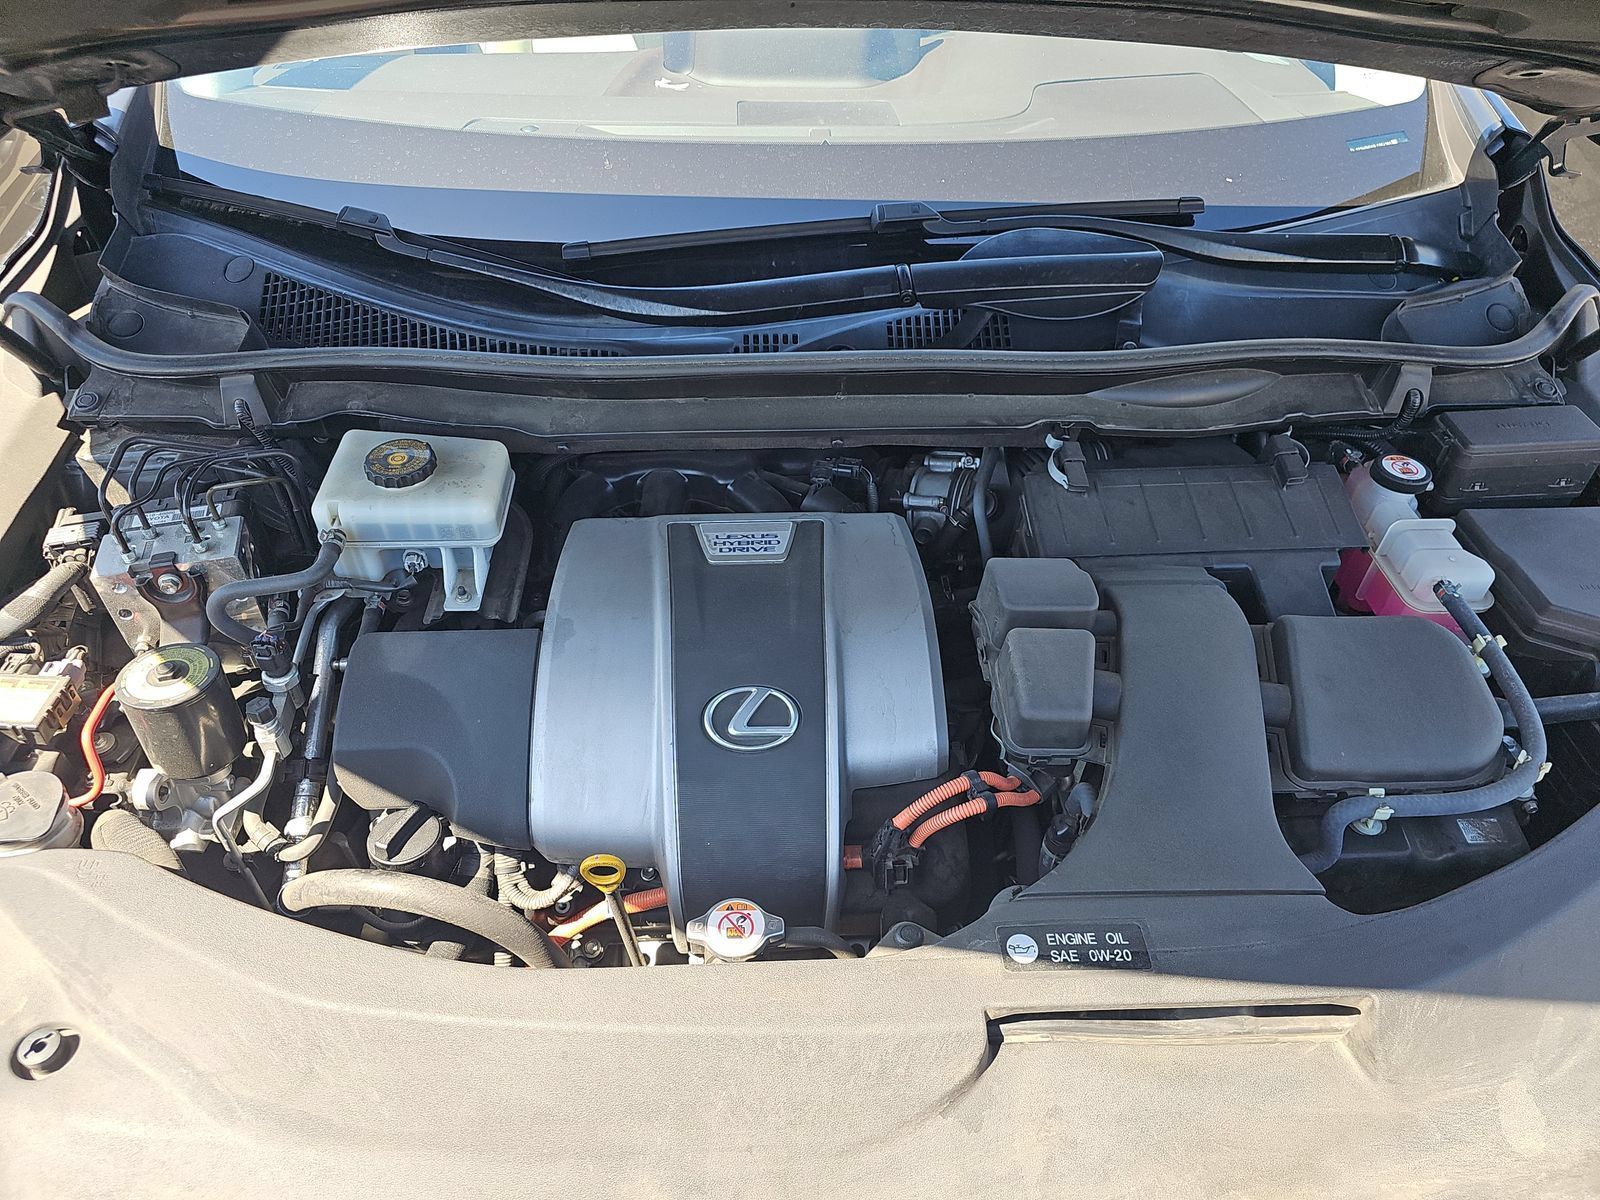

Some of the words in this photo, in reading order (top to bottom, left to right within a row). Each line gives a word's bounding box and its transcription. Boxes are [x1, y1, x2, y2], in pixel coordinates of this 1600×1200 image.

[713, 539, 781, 547] HYBRID
[1045, 932, 1098, 946] ENGINE
[1105, 932, 1130, 945] OIL
[1050, 949, 1080, 963] SAE
[1088, 949, 1132, 962] 0W-20
